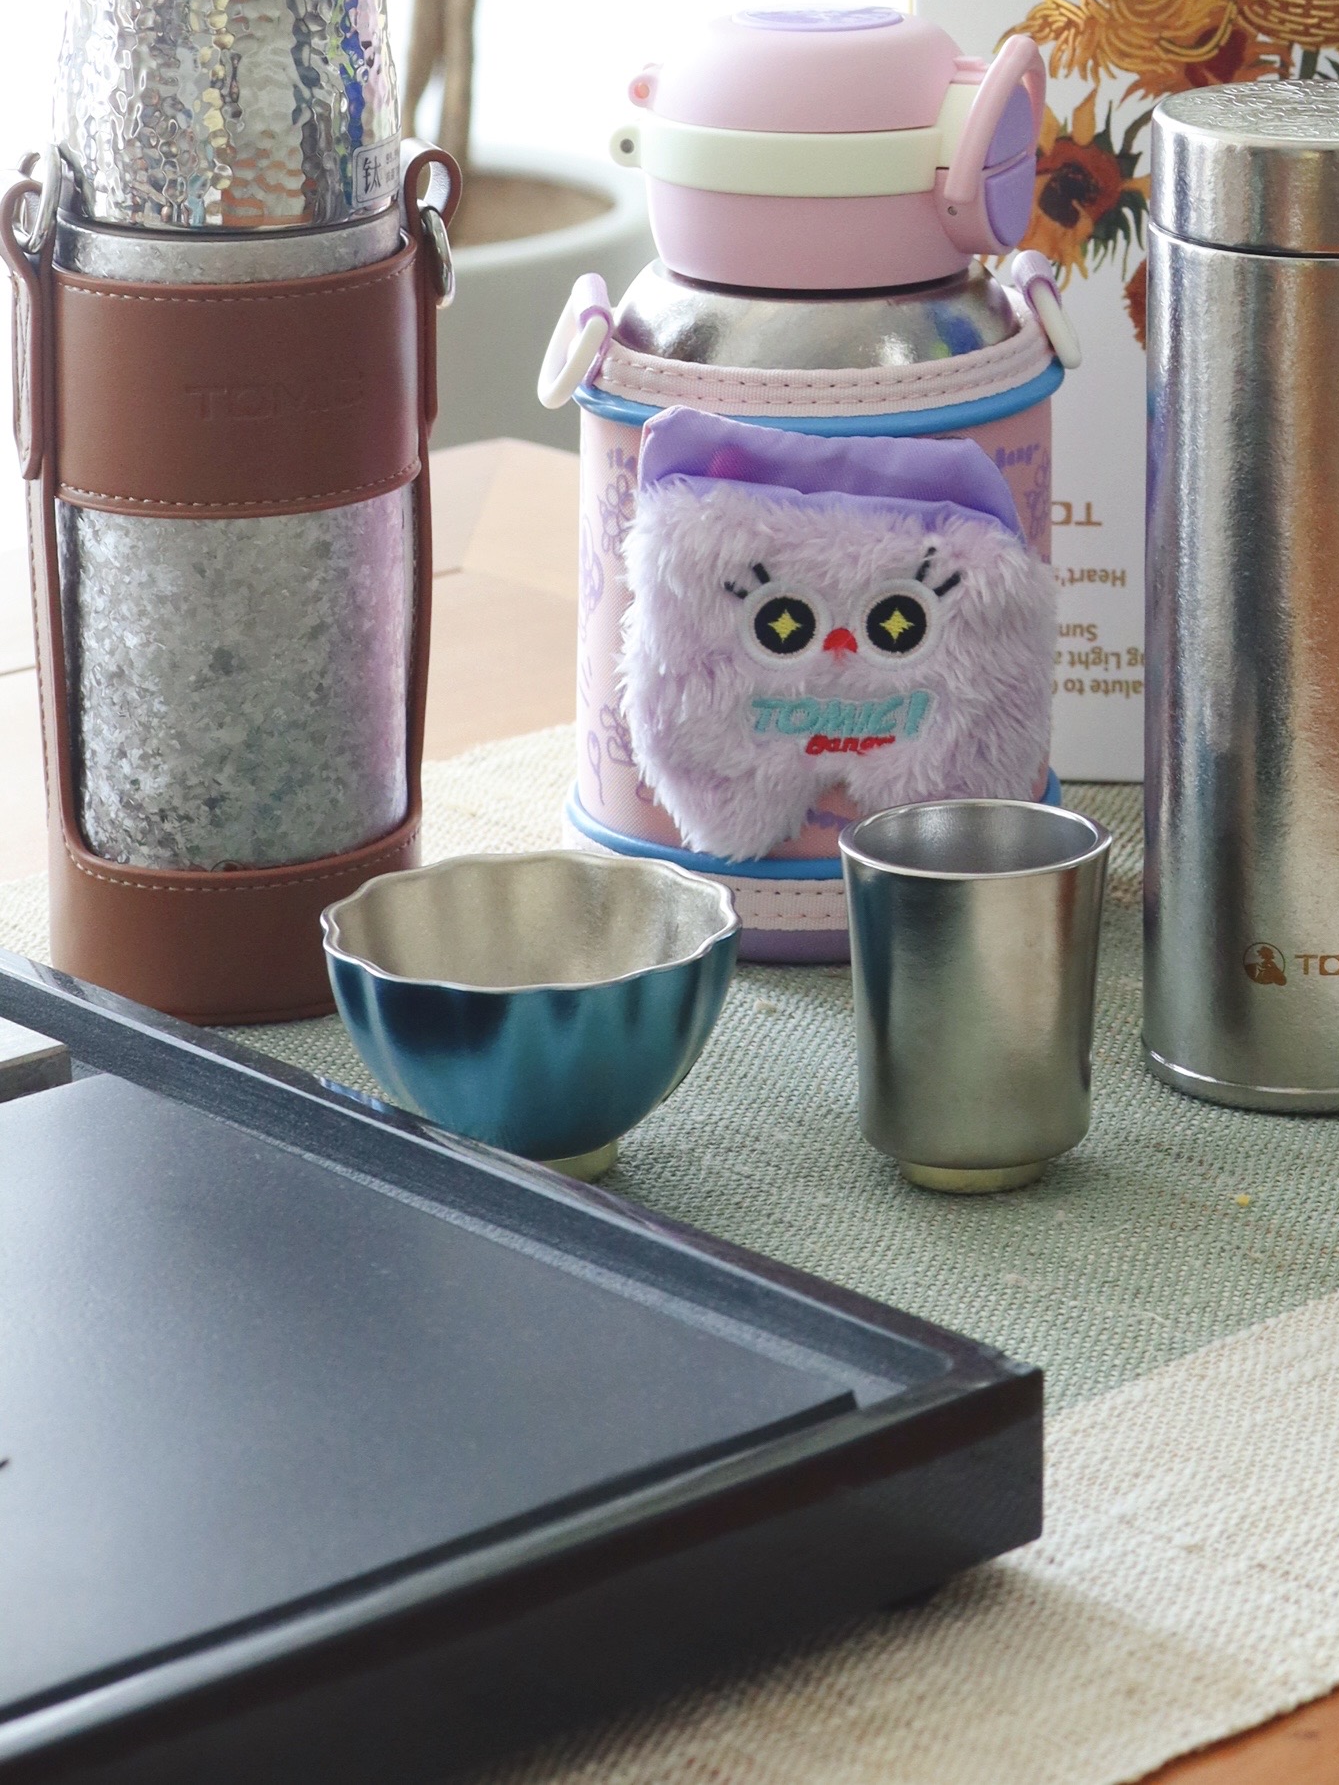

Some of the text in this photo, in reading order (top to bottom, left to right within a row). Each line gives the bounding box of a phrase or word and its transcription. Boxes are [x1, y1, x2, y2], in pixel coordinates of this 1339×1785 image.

[362, 155, 382, 194] 钛
[1067, 646, 1122, 671] Light
[1090, 677, 1144, 699] alute
